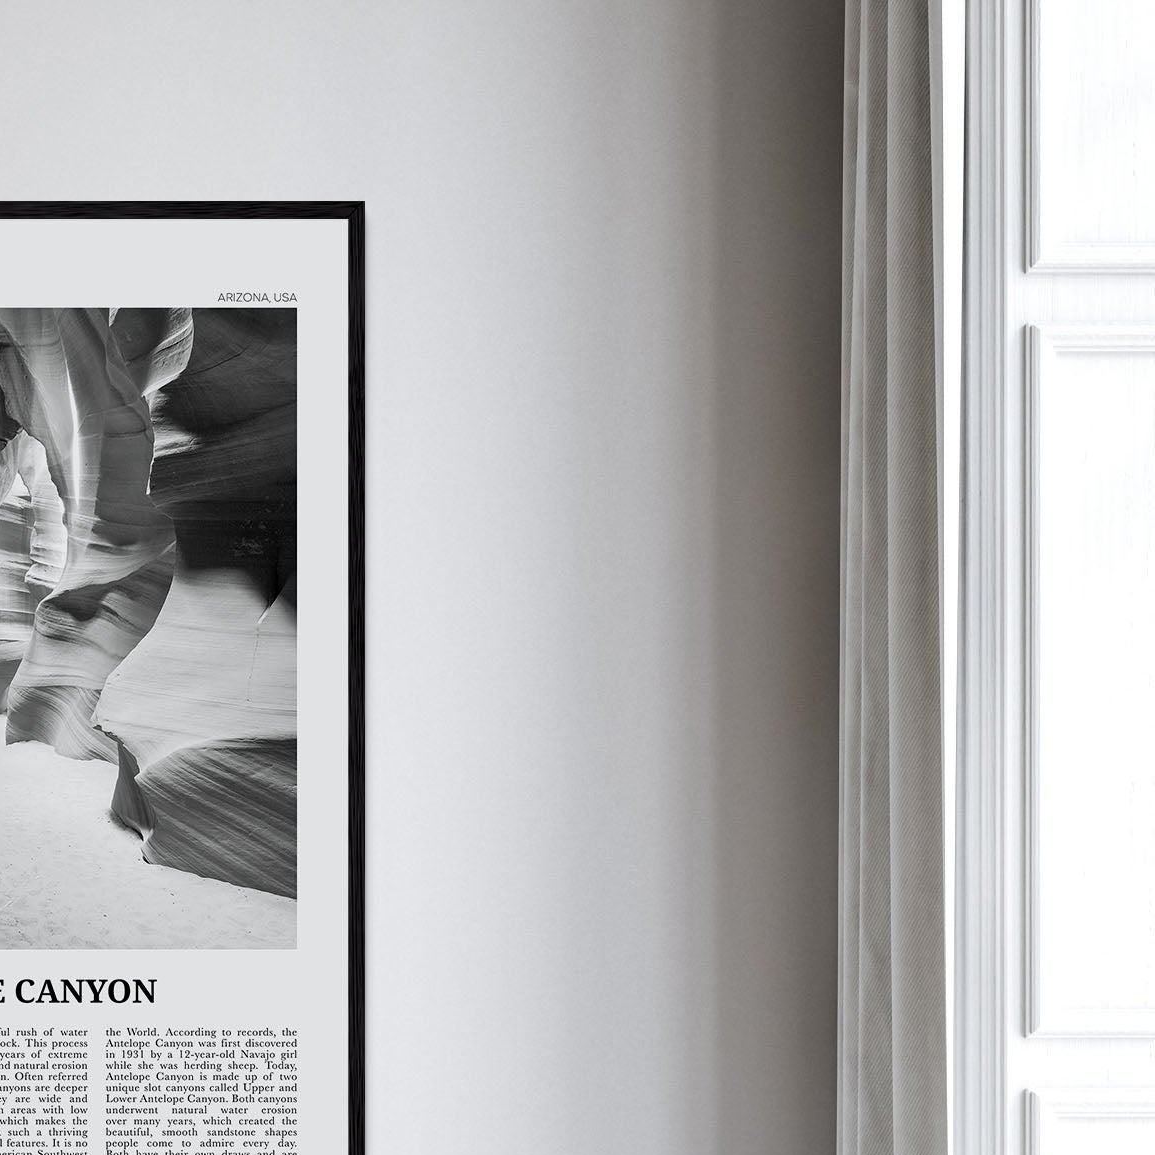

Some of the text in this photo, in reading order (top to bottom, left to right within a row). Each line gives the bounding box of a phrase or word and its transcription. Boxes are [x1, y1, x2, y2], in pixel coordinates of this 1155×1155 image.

[217, 293, 298, 303] ARIZONA, USA
[15, 979, 158, 1003] CANYON
[16, 1028, 37, 1036] rush
[43, 1028, 55, 1036] of
[106, 1028, 121, 1036] the
[126, 1028, 160, 1036] World.
[165, 1028, 217, 1039] According
[237, 1028, 276, 1038] records,
[282, 1028, 297, 1036] the
[24, 1039, 48, 1048] This
[52, 1041, 88, 1050] process
[105, 1039, 150, 1050] Antelope
[155, 1039, 193, 1050] Canyon
[221, 1039, 241, 1048] first
[245, 1039, 297, 1048] discovered
[106, 1050, 115, 1059] in
[122, 1050, 144, 1059] 1931
[150, 1050, 162, 1061] by
[180, 1050, 235, 1061] 12-year-old
[240, 1050, 276, 1061] Navajo
[280, 1050, 297, 1061] girl
[13, 1061, 49, 1070] natural
[51, 1061, 88, 1070] erosion
[105, 1061, 132, 1070] while
[137, 1061, 154, 1070] she
[184, 1061, 222, 1073] herding
[228, 1061, 258, 1073] sheep.
[264, 1061, 297, 1073] Today,
[14, 1072, 43, 1081] Often
[48, 1072, 88, 1081] referred
[38, 1094, 62, 1103] wide
[69, 1094, 88, 1103] and
[106, 1094, 298, 1106] Lower Antelope Canyon. Both canyons
[106, 1105, 297, 1114] underwent natural water erosion
[0, 1116, 28, 1125] which
[35, 1116, 66, 1125] makes
[72, 1116, 88, 1125] the
[134, 1119, 161, 1128] many
[167, 1119, 196, 1128] years,
[202, 1116, 232, 1125] which
[238, 1116, 275, 1125] created
[282, 1116, 297, 1125] the
[8, 1127, 30, 1136] such
[48, 1127, 88, 1139] thriving
[105, 1139, 138, 1150] people
[199, 1139, 235, 1147] admire
[243, 1141, 270, 1150] every
[277, 1139, 297, 1150] day.
